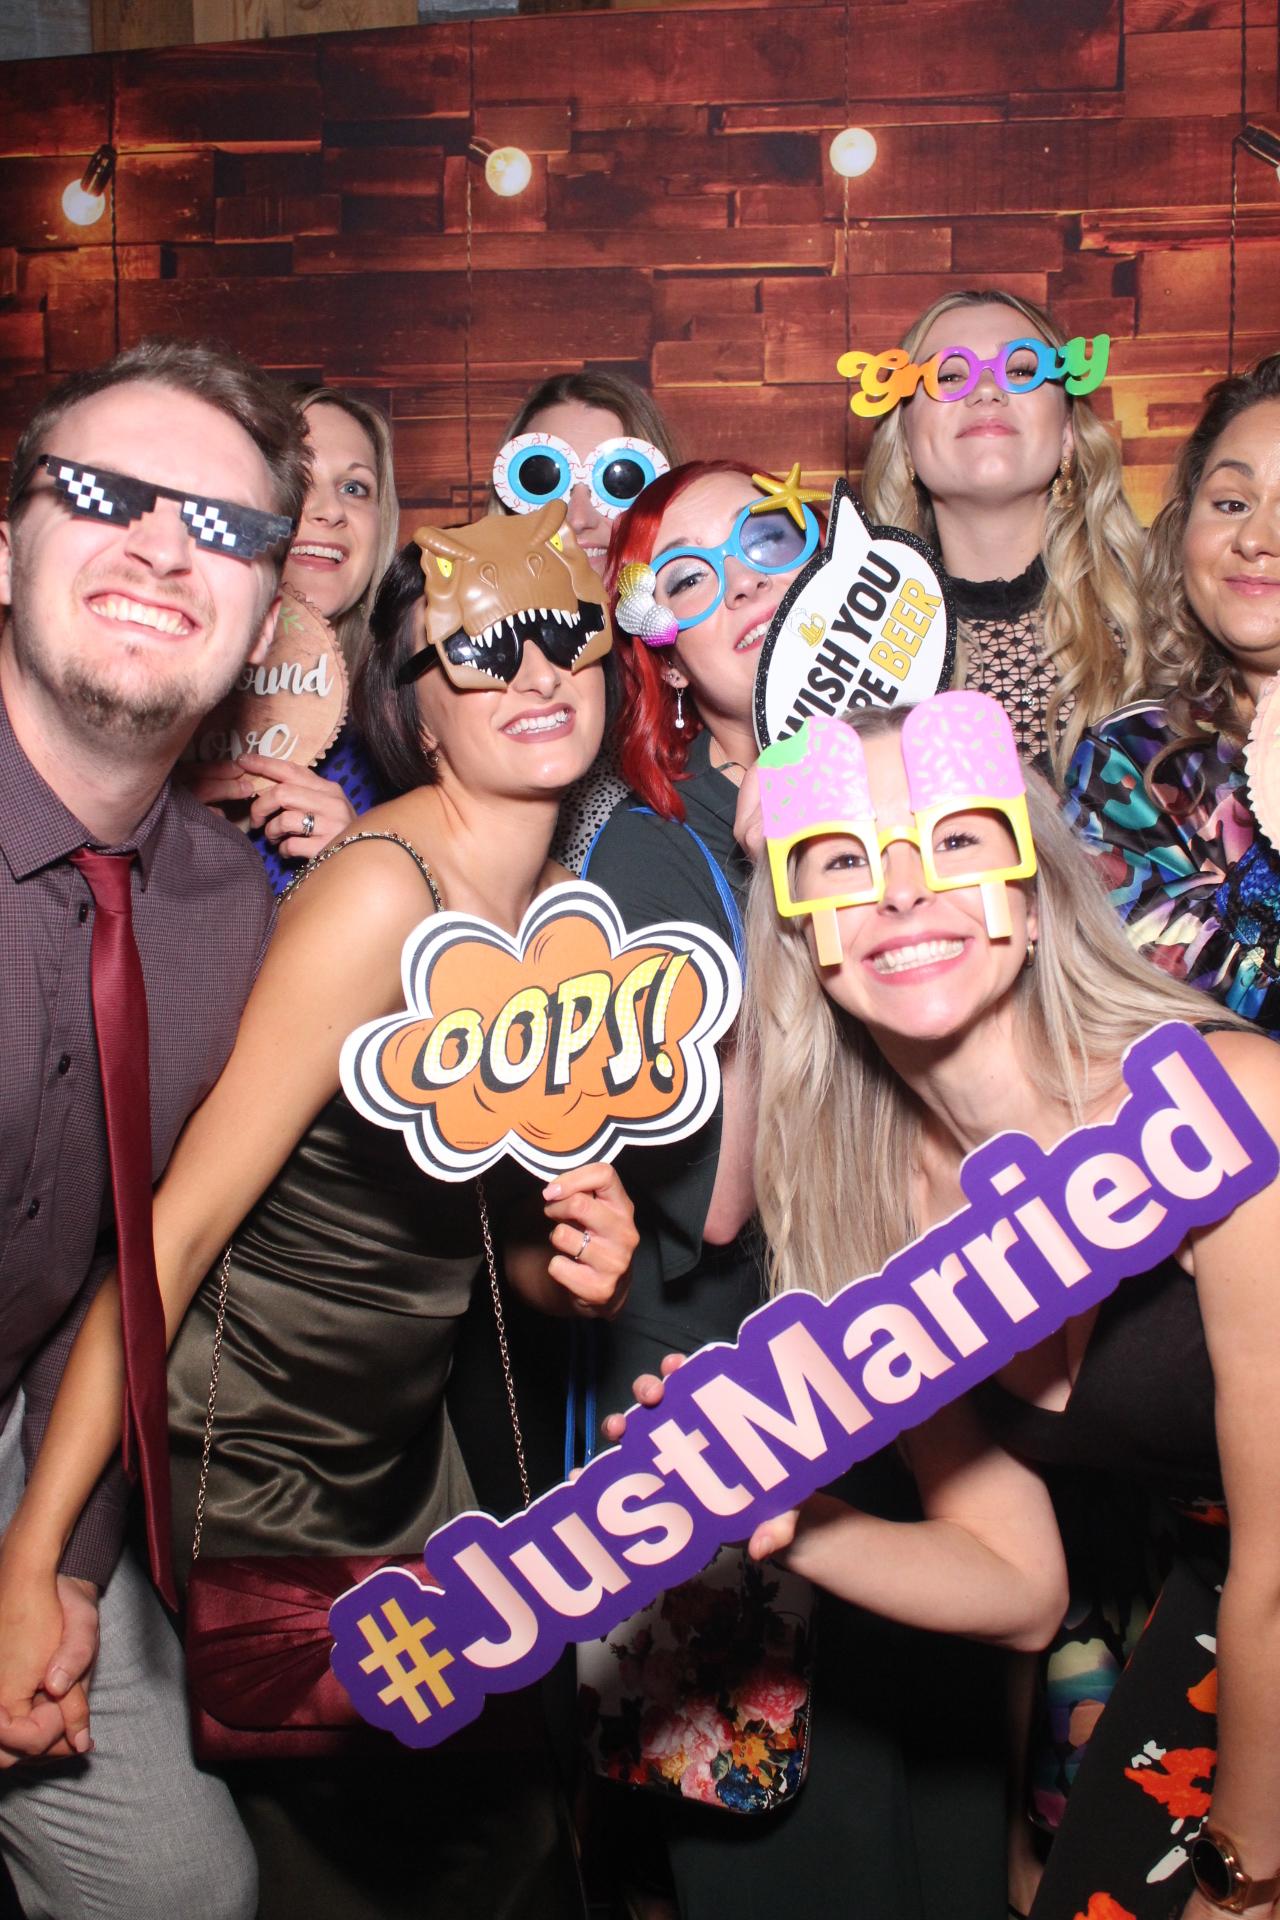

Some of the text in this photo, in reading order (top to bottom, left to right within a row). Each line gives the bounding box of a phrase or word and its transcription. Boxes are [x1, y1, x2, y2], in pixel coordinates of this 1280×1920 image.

[831, 551, 901, 644] YOU
[869, 578, 942, 681] BEER
[411, 950, 695, 1096] OOPS!
[356, 1050, 1253, 1724] #JustMarried
